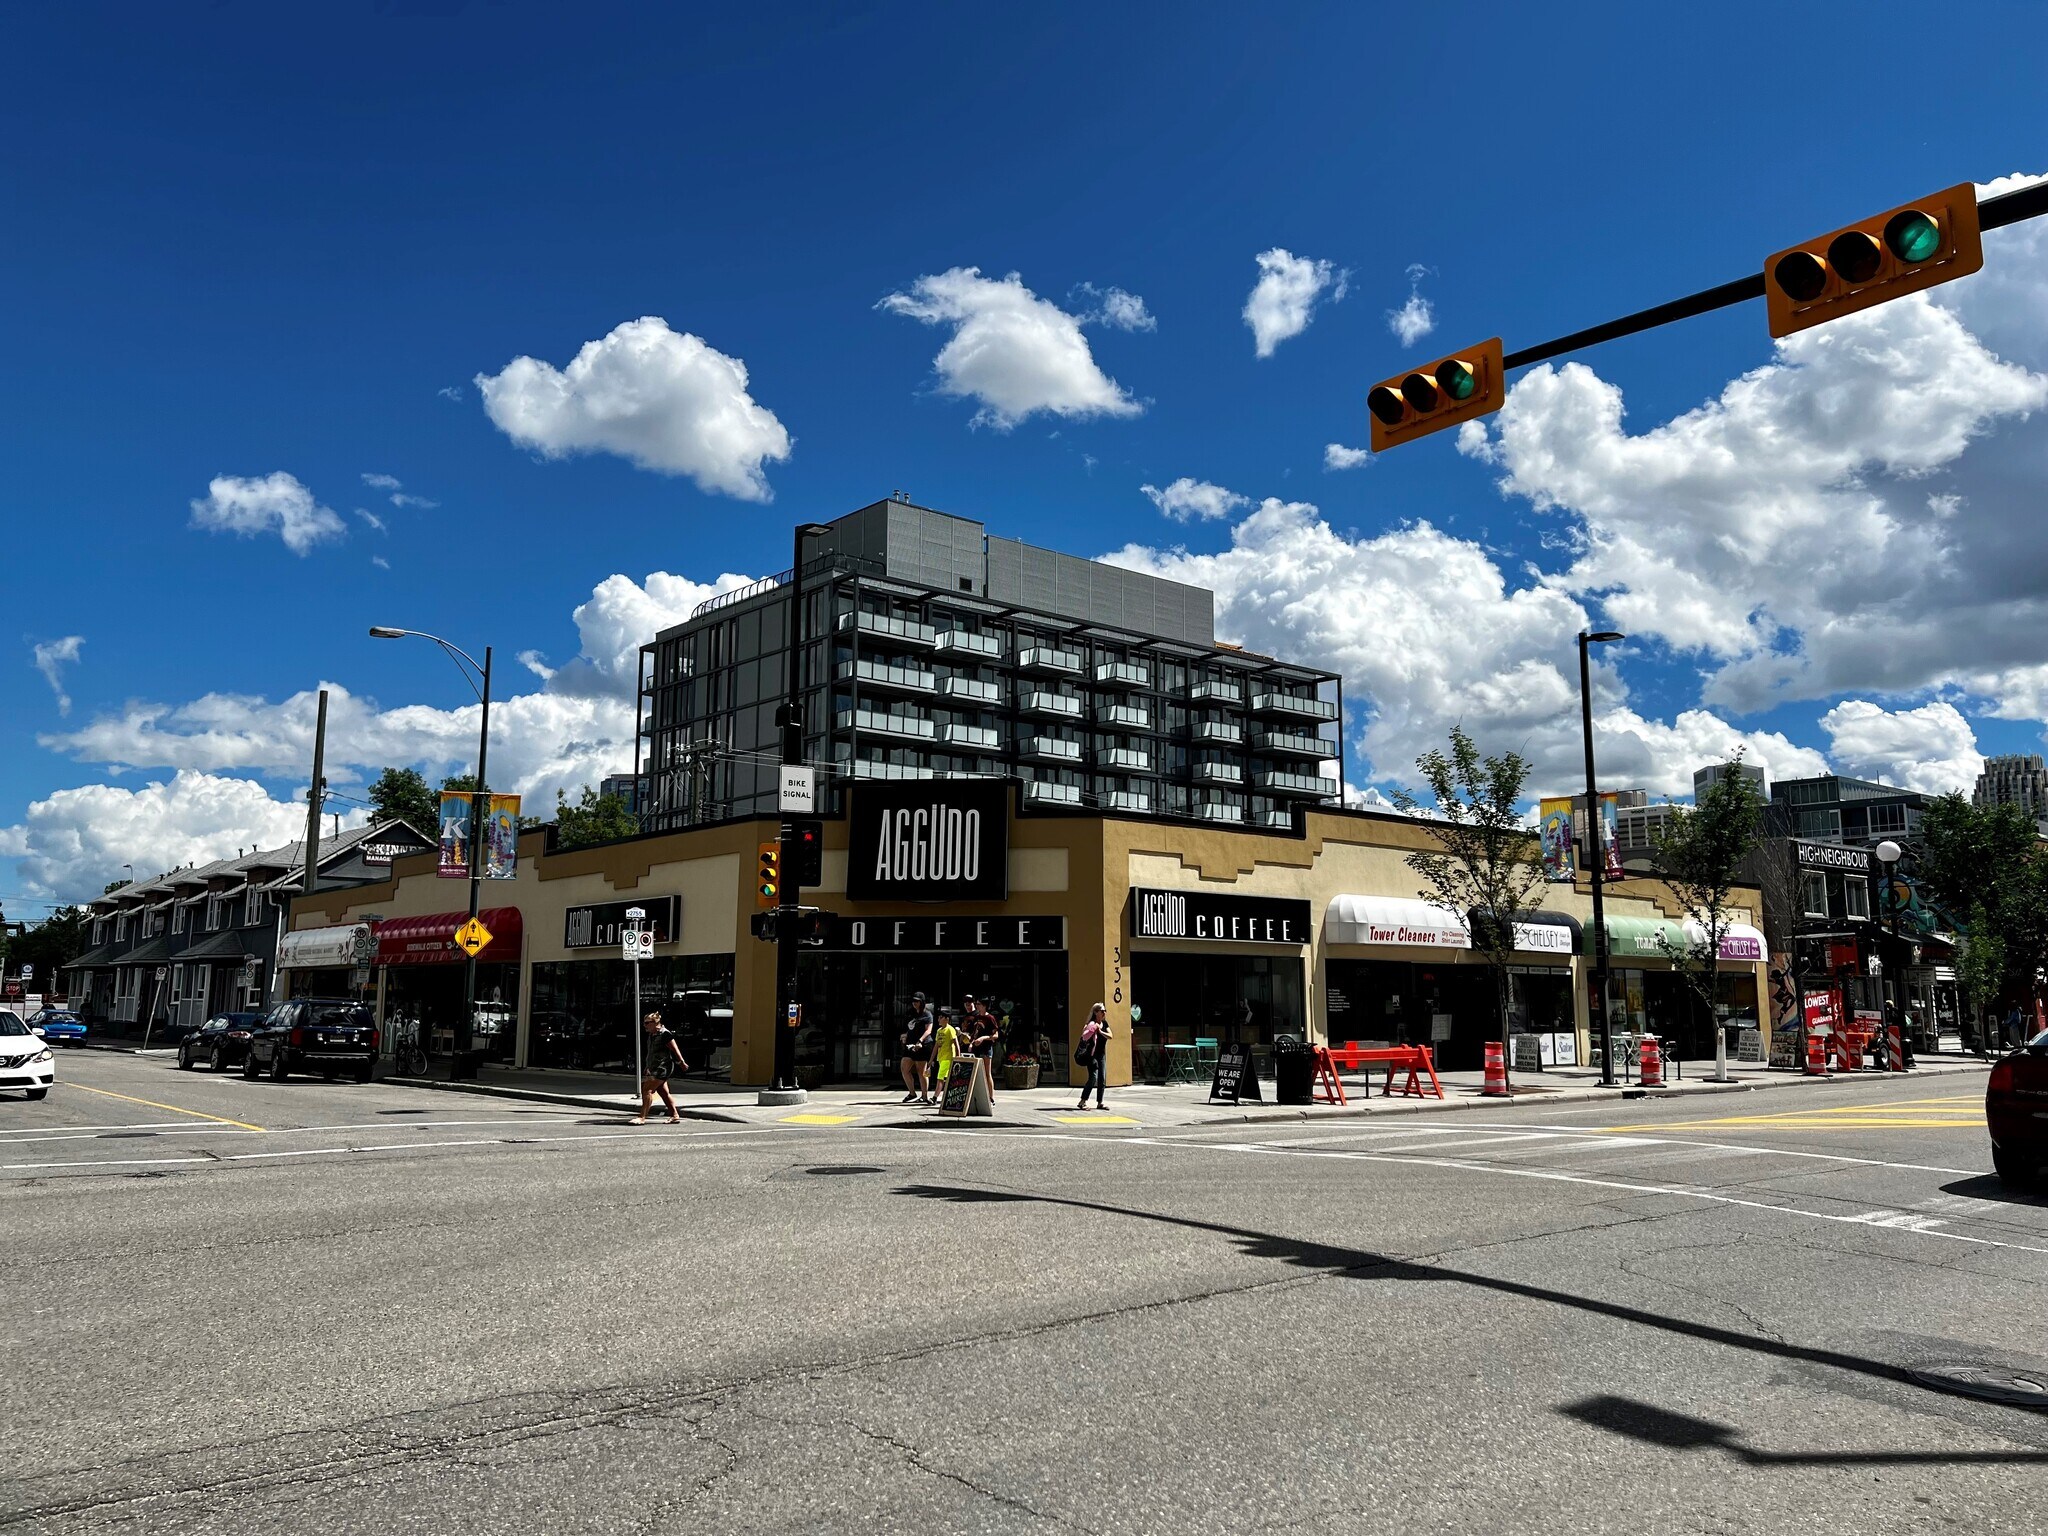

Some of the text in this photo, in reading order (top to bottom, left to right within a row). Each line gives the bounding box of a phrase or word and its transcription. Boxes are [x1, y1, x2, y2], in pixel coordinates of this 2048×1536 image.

[788, 779, 807, 788] BIKE
[782, 790, 811, 799] SIGNAL
[441, 816, 468, 838] K
[875, 804, 980, 881] AGGÜDO
[1143, 893, 1186, 936] AGGÜDO
[1196, 914, 1291, 941] COFFEE
[811, 921, 1030, 946] OFFEE
[1370, 926, 1436, 943] Tower Cleaners
[1526, 929, 1558, 948] CHELSEY
[1728, 940, 1750, 956] CHELSEY
[1113, 947, 1122, 1003] 338
[1804, 994, 1830, 1008] LOWEST
[1557, 1041, 1573, 1053] Salon
[1218, 1069, 1241, 1078] WE ARE
[1219, 1078, 1236, 1087] OPEN
